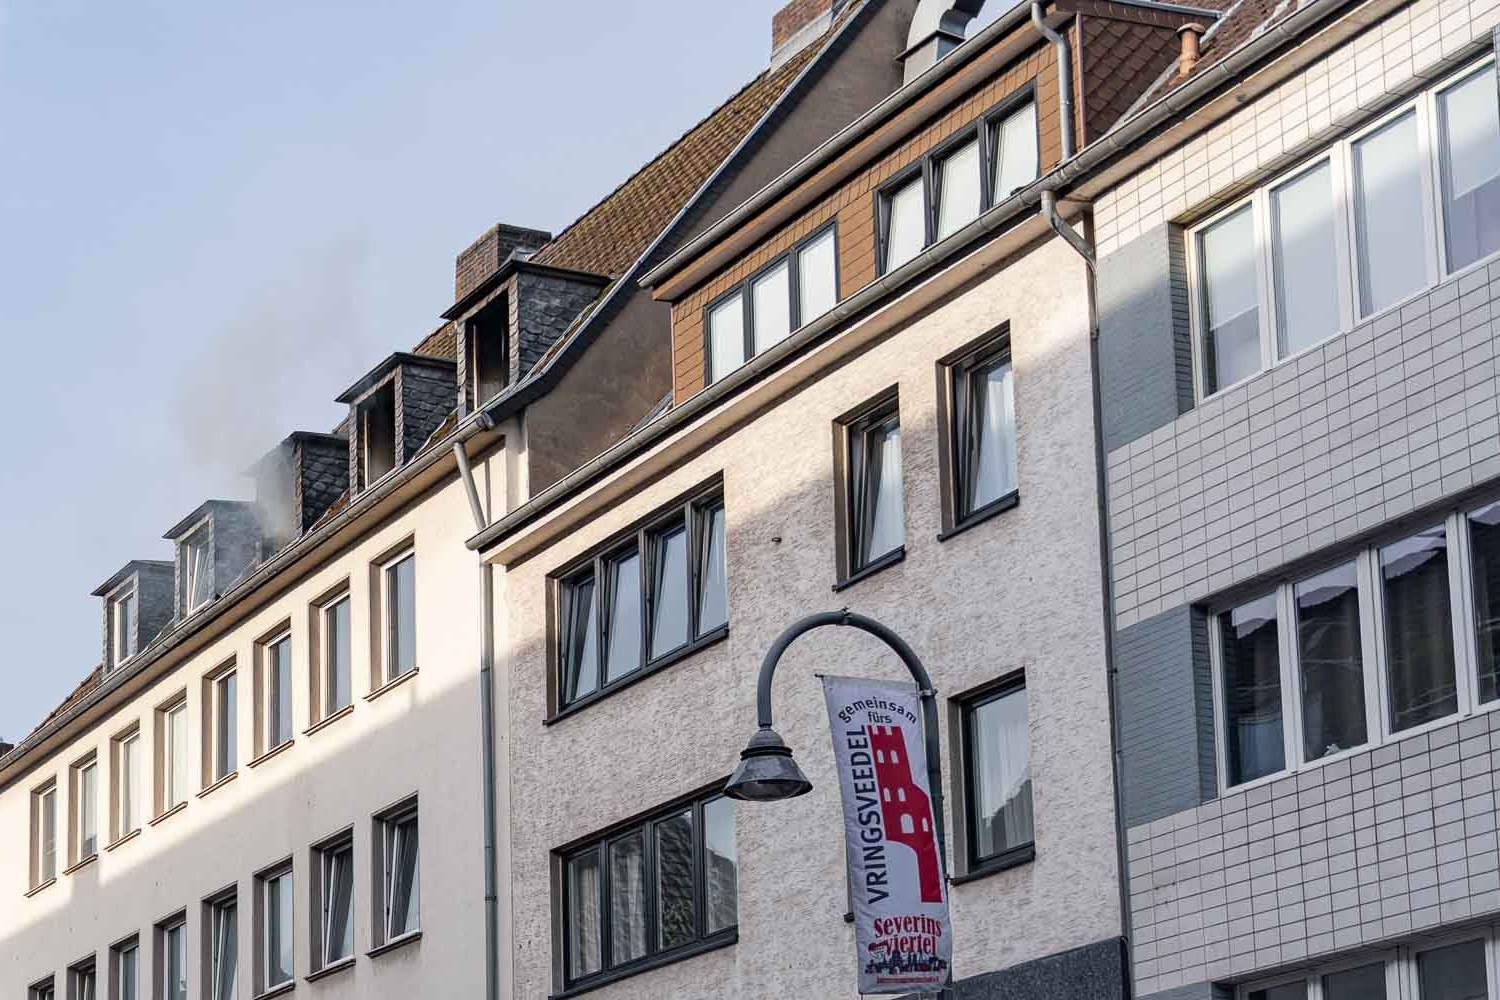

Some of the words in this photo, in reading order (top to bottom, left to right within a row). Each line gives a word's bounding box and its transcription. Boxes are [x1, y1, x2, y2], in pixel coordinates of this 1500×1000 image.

[838, 696, 917, 724] gemeinsam
[868, 711, 892, 723] fürs
[846, 724, 889, 904] VRINGSVEEDEL
[874, 913, 942, 938] Severins
[885, 933, 936, 957] viertel
